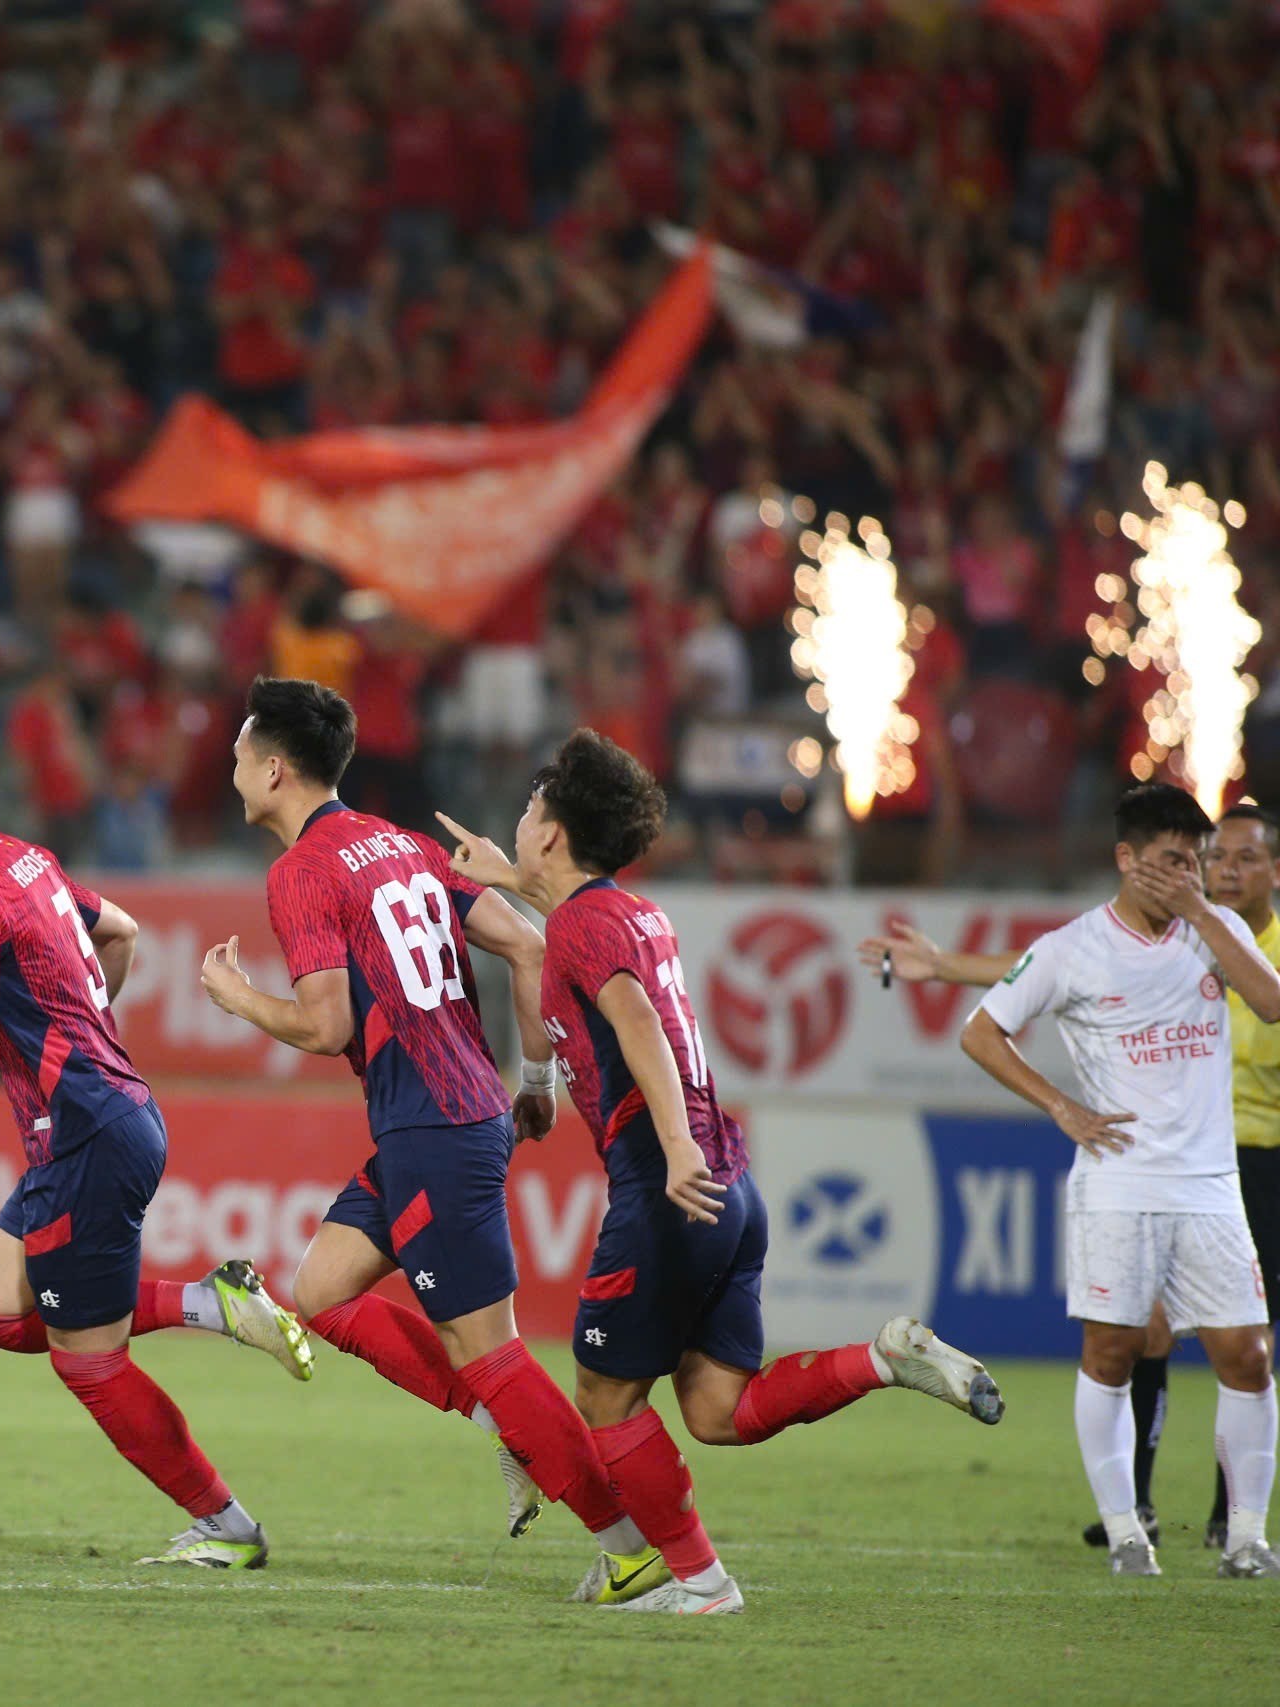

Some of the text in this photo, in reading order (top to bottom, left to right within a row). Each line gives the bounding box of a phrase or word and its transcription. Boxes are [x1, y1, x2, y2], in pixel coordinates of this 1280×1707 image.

[371, 872, 466, 1011] 68
[1164, 1020, 1219, 1042] CÔNG
[1128, 1042, 1215, 1065] VIETTEL
